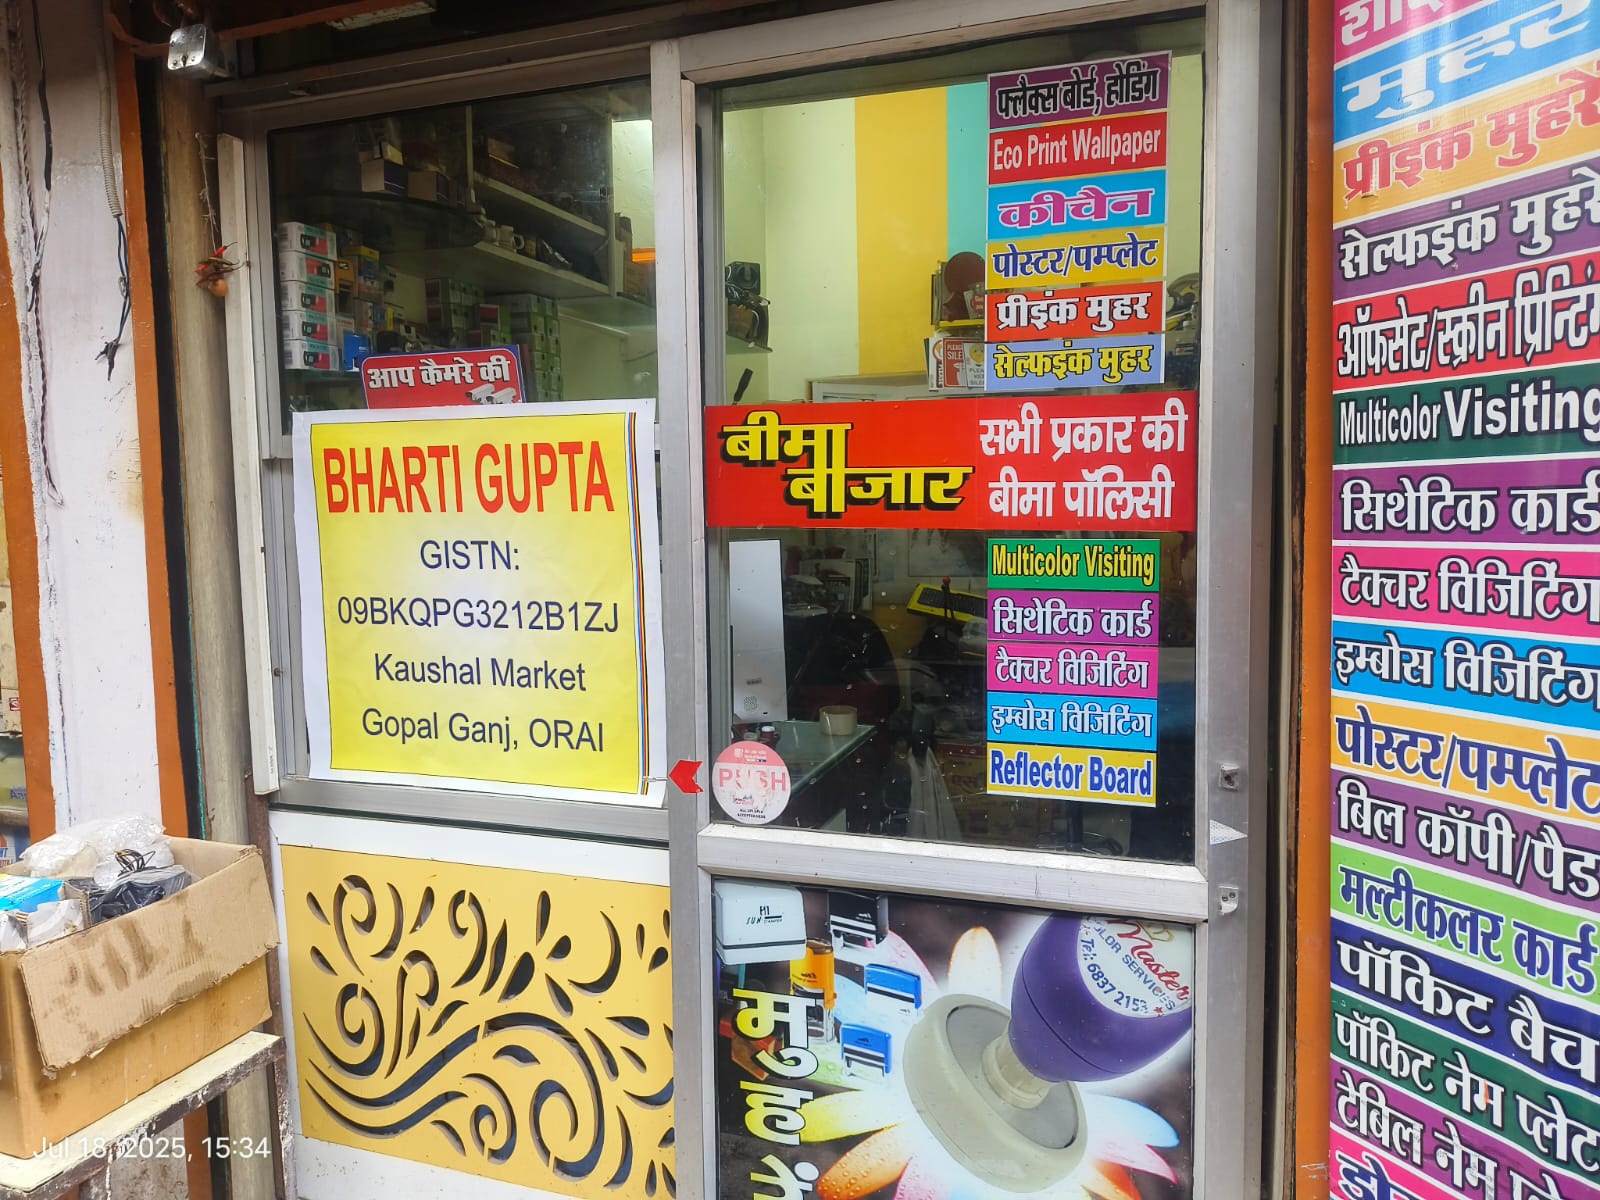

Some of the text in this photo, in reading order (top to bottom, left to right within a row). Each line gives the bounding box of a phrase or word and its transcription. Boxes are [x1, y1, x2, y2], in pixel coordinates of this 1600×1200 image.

[1342, 0, 1591, 119] मुहर
[997, 74, 1059, 118] फ्लैक्स
[993, 125, 1161, 170] Eco Print Wallpaper
[1342, 119, 1476, 202] प्रीइंक
[998, 185, 1155, 229] कीचैन
[993, 232, 1159, 278] पोस्टर/पम्प्लेट
[1339, 200, 1500, 281] सेल्फइंक
[996, 289, 1080, 331] प्रीइंक
[1085, 292, 1152, 332] मुहर
[367, 355, 511, 389] आप कैमरे की
[947, 351, 964, 360] SILE
[993, 340, 1154, 384] सेल्फइंक मुहर
[978, 397, 1190, 462] सभी प्रकार की
[1339, 379, 1600, 446] Multicolor Visiting
[720, 410, 853, 464] बीमा
[322, 441, 615, 514] BHARTI GUPTA
[784, 464, 973, 519] बाजार
[988, 463, 1176, 521] बीमा पॉलिसी
[1341, 475, 1498, 533] सिथेटिक
[420, 540, 520, 571] GISTN:
[991, 544, 1155, 586] Multicolor Visiting
[1340, 553, 1430, 610] टैक्चर
[337, 597, 619, 633] 09BKQPG3212B1ZJ
[992, 597, 1153, 639] सिथेटिक कार्ड
[374, 653, 586, 692] Kaushal Market
[995, 646, 1053, 685] टैक्चर
[1335, 632, 1434, 686] इम्बोस
[362, 708, 604, 752] Gopal Ganj, ORAI
[991, 698, 1056, 735] इम्बोस
[719, 768, 787, 792] PSH
[990, 749, 1152, 796] Reflector Board
[1338, 778, 1600, 899] बिल कॉपी/पैड
[1338, 867, 1598, 995] मल्टीकलर कार्ड
[1087, 963, 1116, 994] 6837
[1337, 940, 1600, 1084] पॉकिट बैच
[1335, 1011, 1435, 1092] पॉकिट
[1443, 1051, 1505, 1128] नेम
[1335, 1070, 1424, 1166] टेबिल
